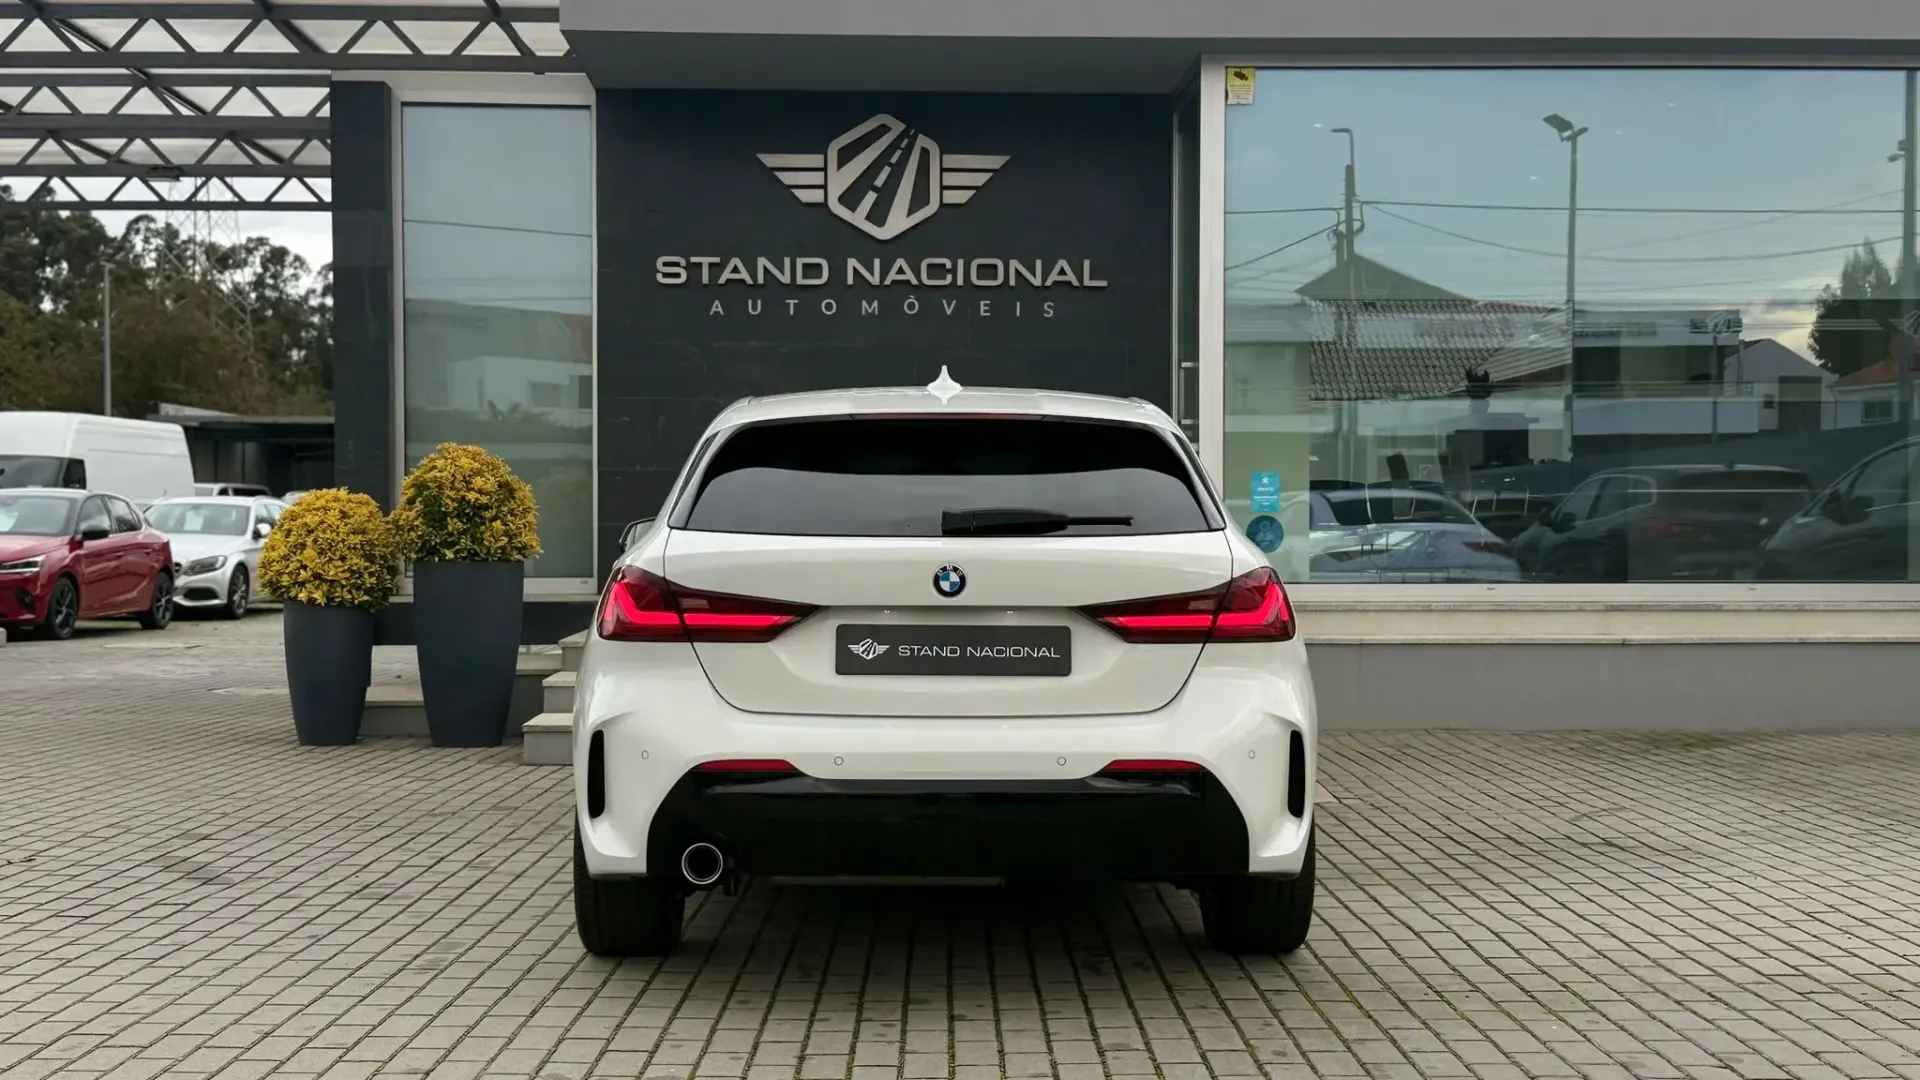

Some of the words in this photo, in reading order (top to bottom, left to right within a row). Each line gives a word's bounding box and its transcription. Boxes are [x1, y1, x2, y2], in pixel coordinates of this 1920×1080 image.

[655, 255, 830, 286] STAND
[846, 257, 1108, 288] NACIONAL
[898, 645, 961, 657] STAND
[966, 646, 1061, 658] NACIONAL
